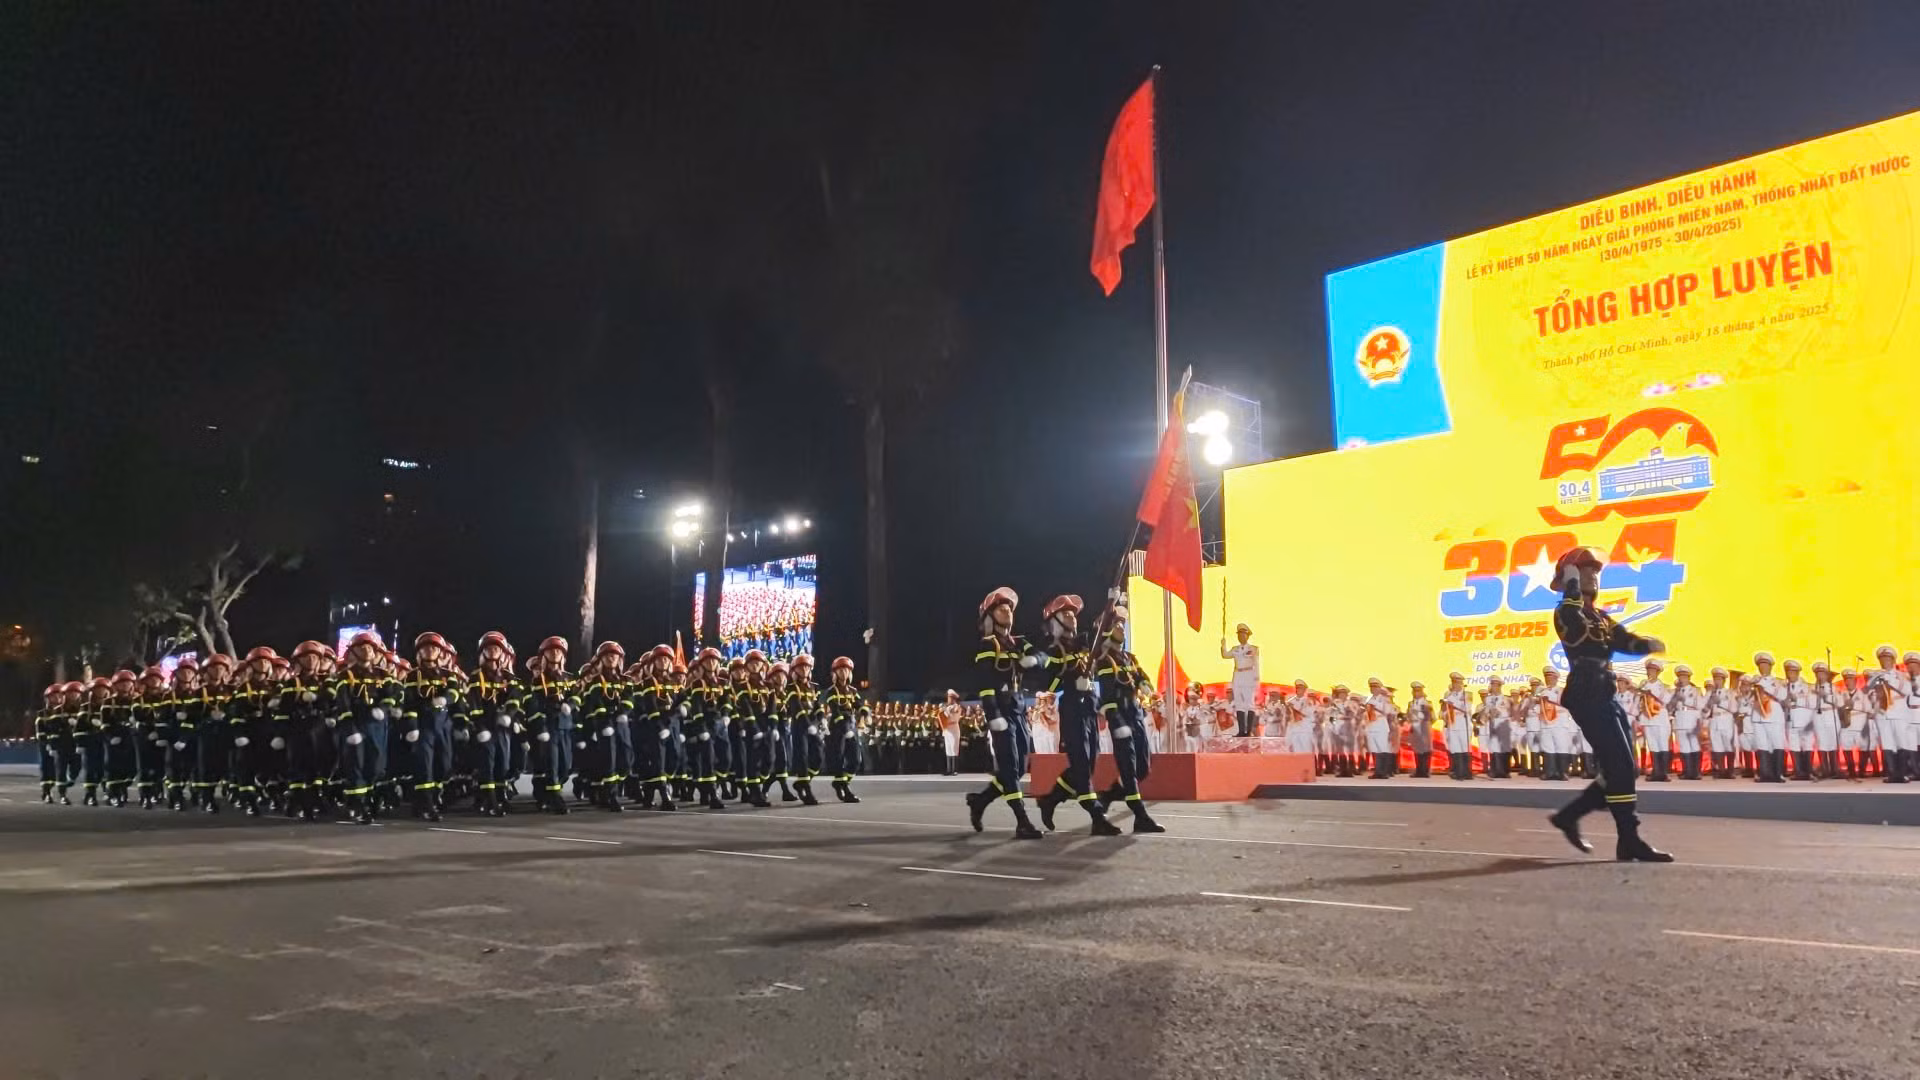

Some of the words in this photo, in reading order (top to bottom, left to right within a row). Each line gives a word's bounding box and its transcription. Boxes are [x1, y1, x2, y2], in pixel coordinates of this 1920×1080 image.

[1619, 196, 1663, 220] BINH,
[1709, 168, 1757, 197] HÀNH
[1527, 251, 1541, 264] 50
[1600, 236, 1663, 263] (30/4/1975
[1674, 216, 1742, 244] 30/4/2025)
[1533, 288, 1619, 338] TỔNG
[1629, 273, 1699, 318] HỢP
[1711, 241, 1833, 299] LUYỆN
[1559, 480, 1590, 497] 30.4
